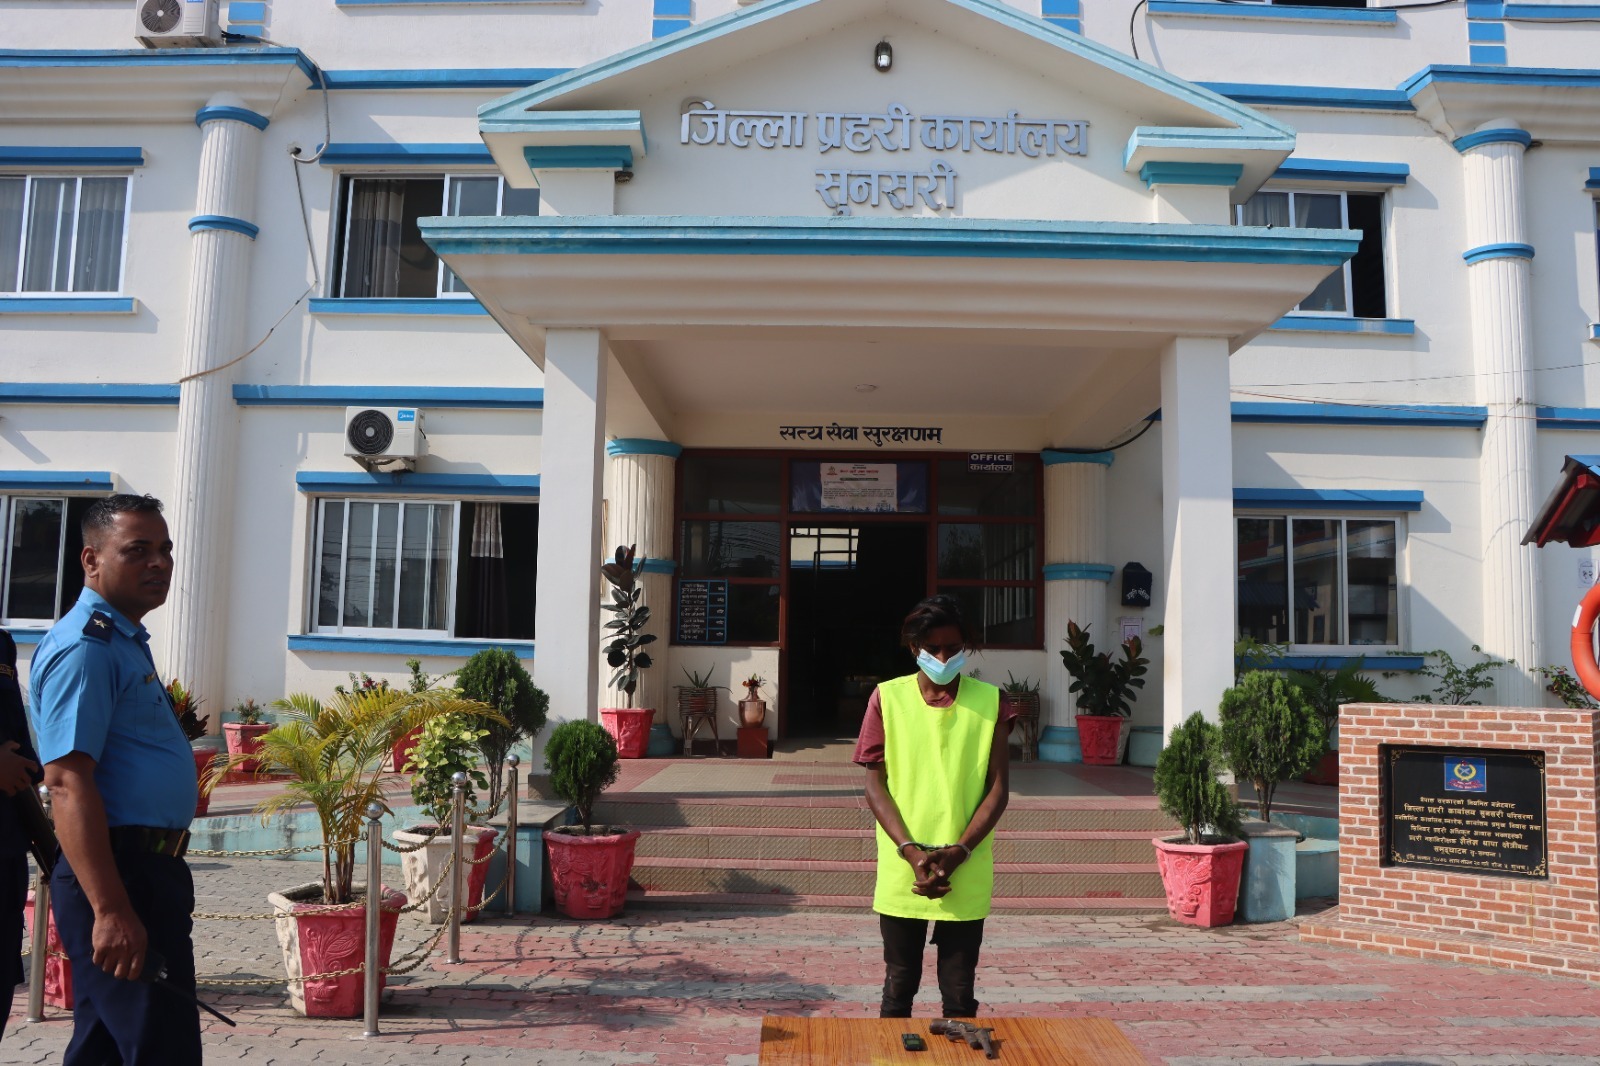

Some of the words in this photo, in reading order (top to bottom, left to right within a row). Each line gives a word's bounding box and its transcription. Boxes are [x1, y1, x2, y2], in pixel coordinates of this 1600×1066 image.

[680, 96, 807, 148] जिल्ला
[816, 102, 914, 152] प्रहरी
[920, 109, 1090, 157] कार्यालय
[815, 160, 957, 216] सुनसरी
[780, 425, 824, 441] सत्य
[826, 422, 858, 441] सेवा
[862, 426, 942, 446] सुरक्षणम्
[970, 453, 1012, 461] OFFICE
[970, 463, 1012, 471] कार्यालय
[1404, 803, 1424, 812] जिल्ला
[1428, 806, 1444, 814] प्रहरी
[1448, 807, 1476, 816] कार्यालय
[1480, 810, 1504, 819] सुनसरी
